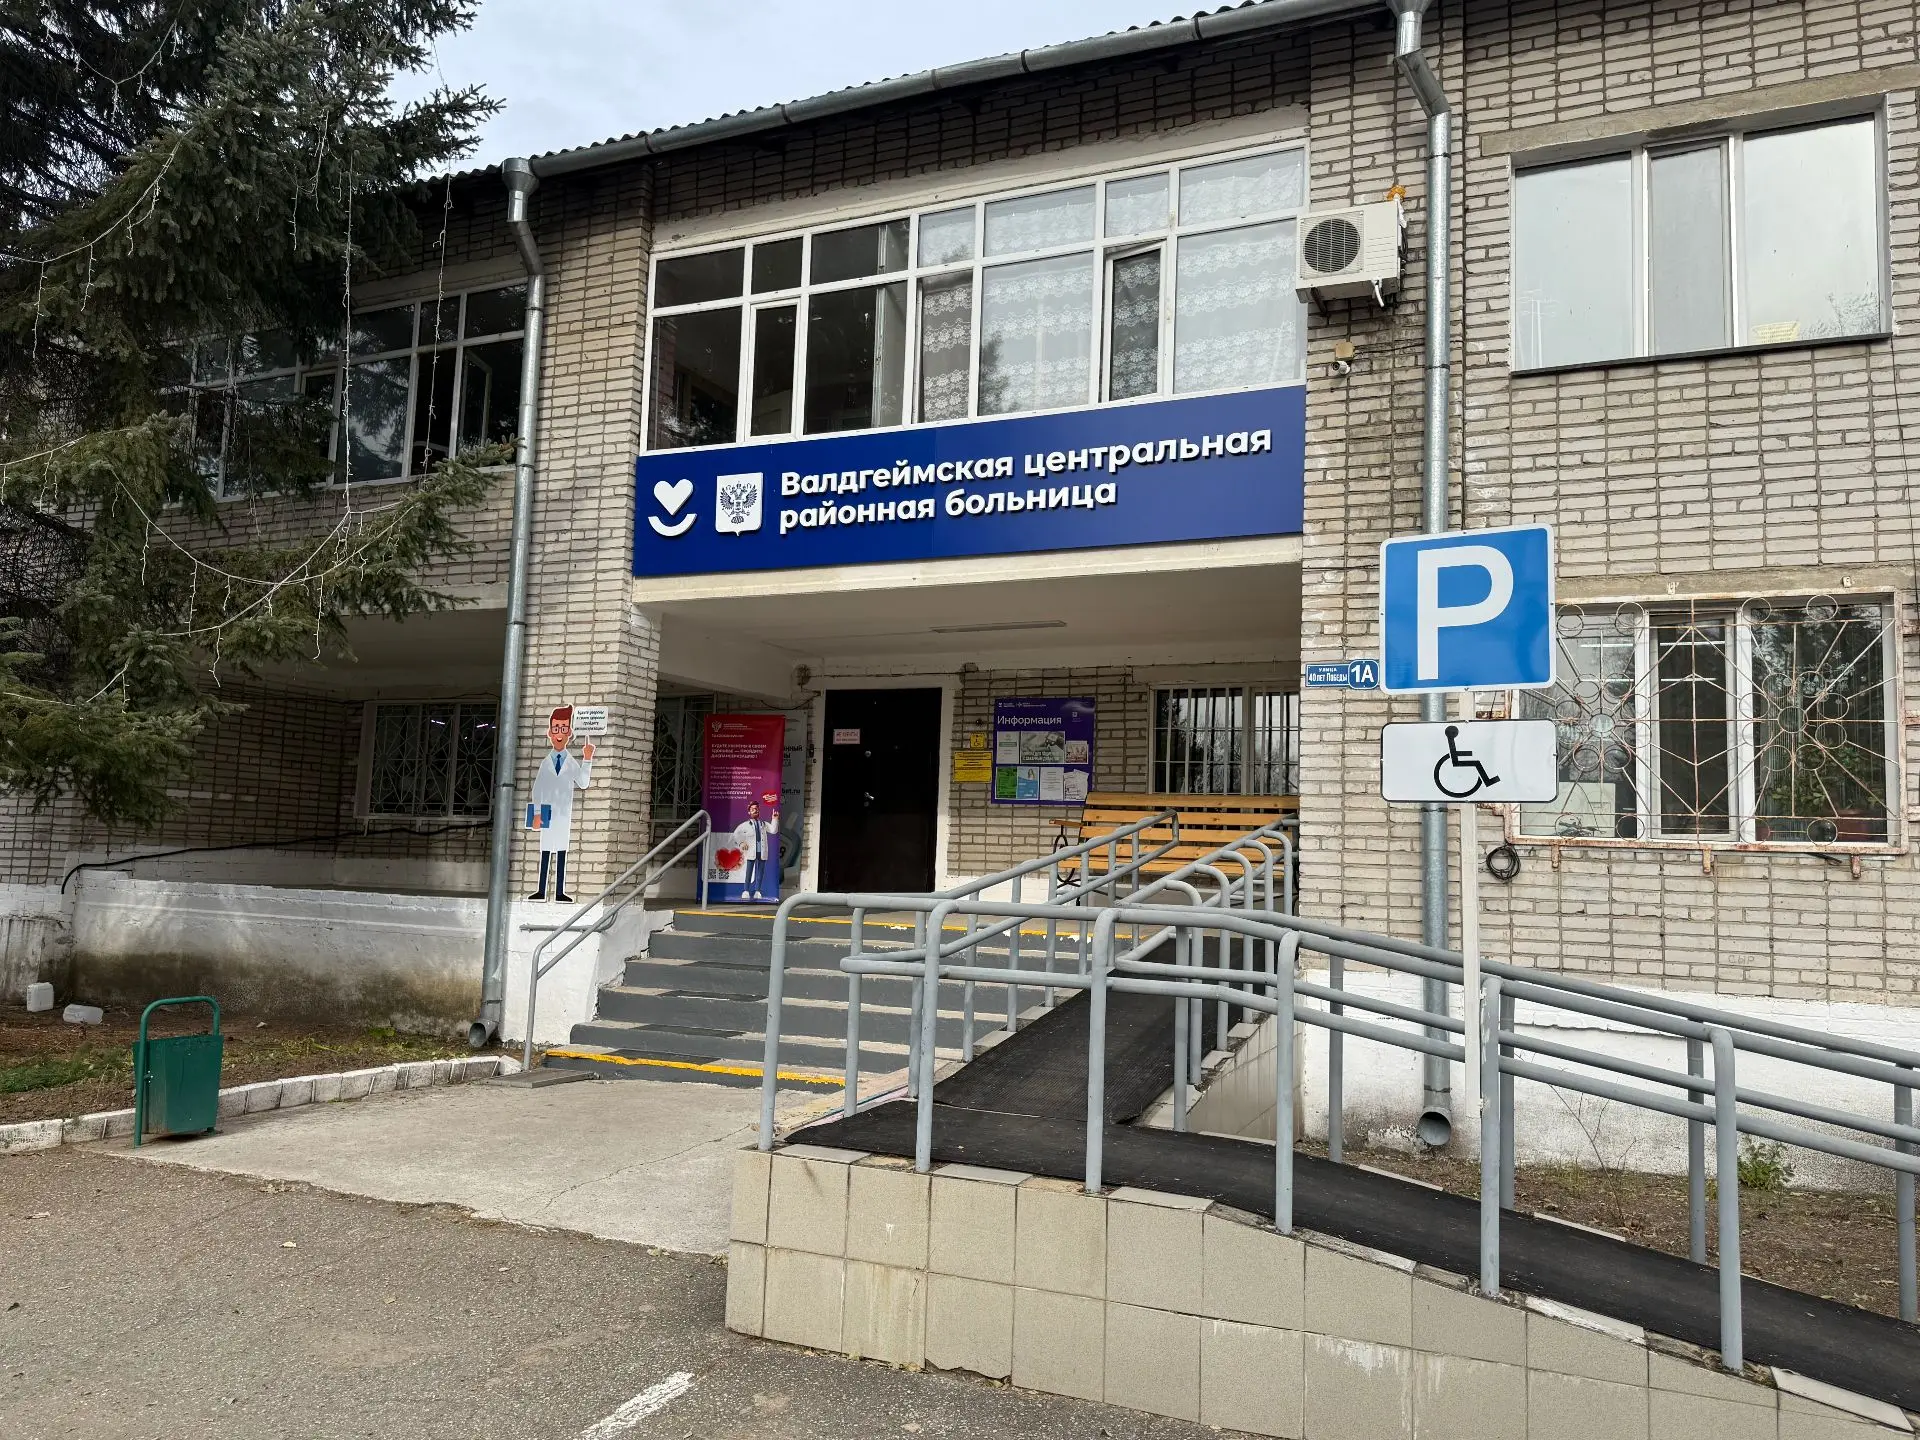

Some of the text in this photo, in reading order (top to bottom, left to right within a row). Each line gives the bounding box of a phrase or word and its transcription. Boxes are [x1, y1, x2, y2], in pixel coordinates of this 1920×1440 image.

[780, 430, 1271, 497] Валдгеймская центральная
[780, 482, 1116, 536] районная больница
[1417, 546, 1514, 681] P
[1308, 673, 1316, 682] 40
[1350, 664, 1375, 683] 1А
[997, 715, 1062, 727] Информация
